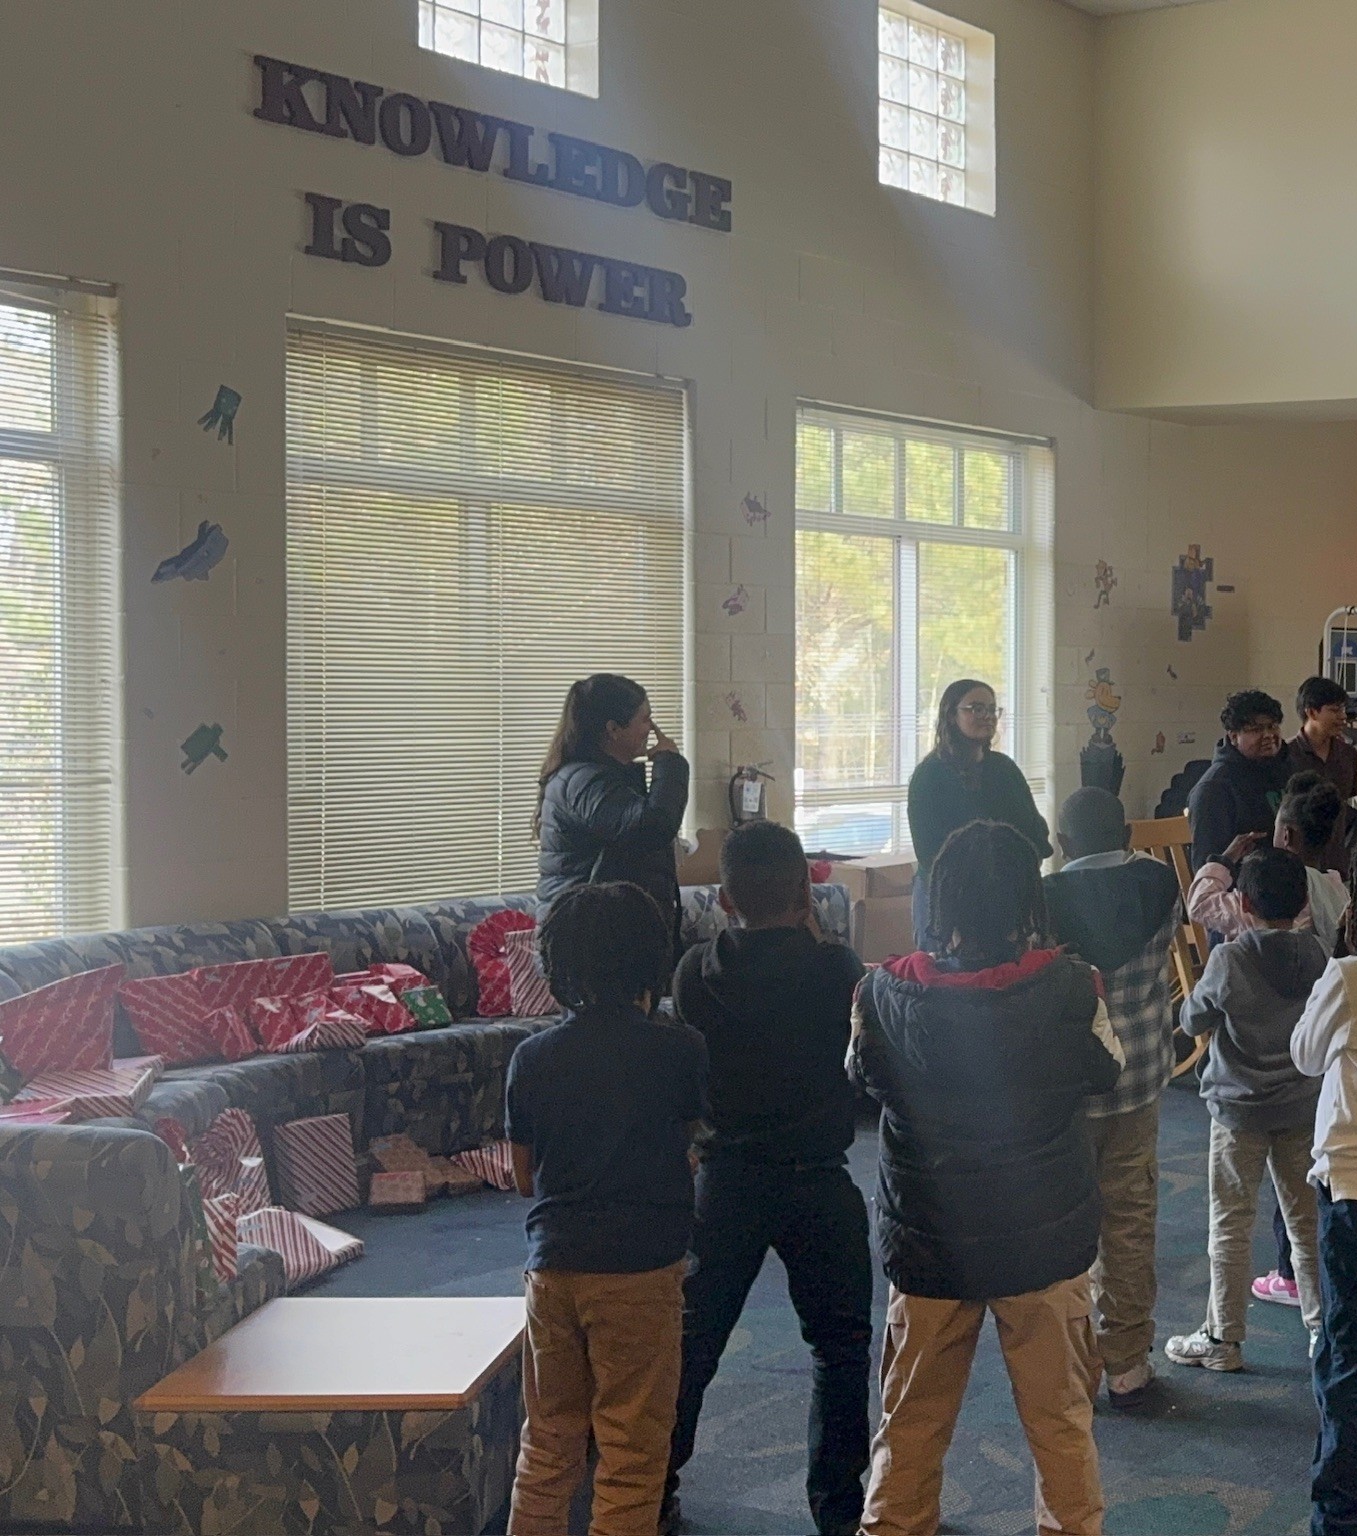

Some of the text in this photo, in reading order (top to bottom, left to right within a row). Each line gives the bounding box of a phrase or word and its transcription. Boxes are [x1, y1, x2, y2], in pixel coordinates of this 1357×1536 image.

[253, 54, 732, 232] KNOWLEDGE
[303, 191, 692, 328] IS POWER
